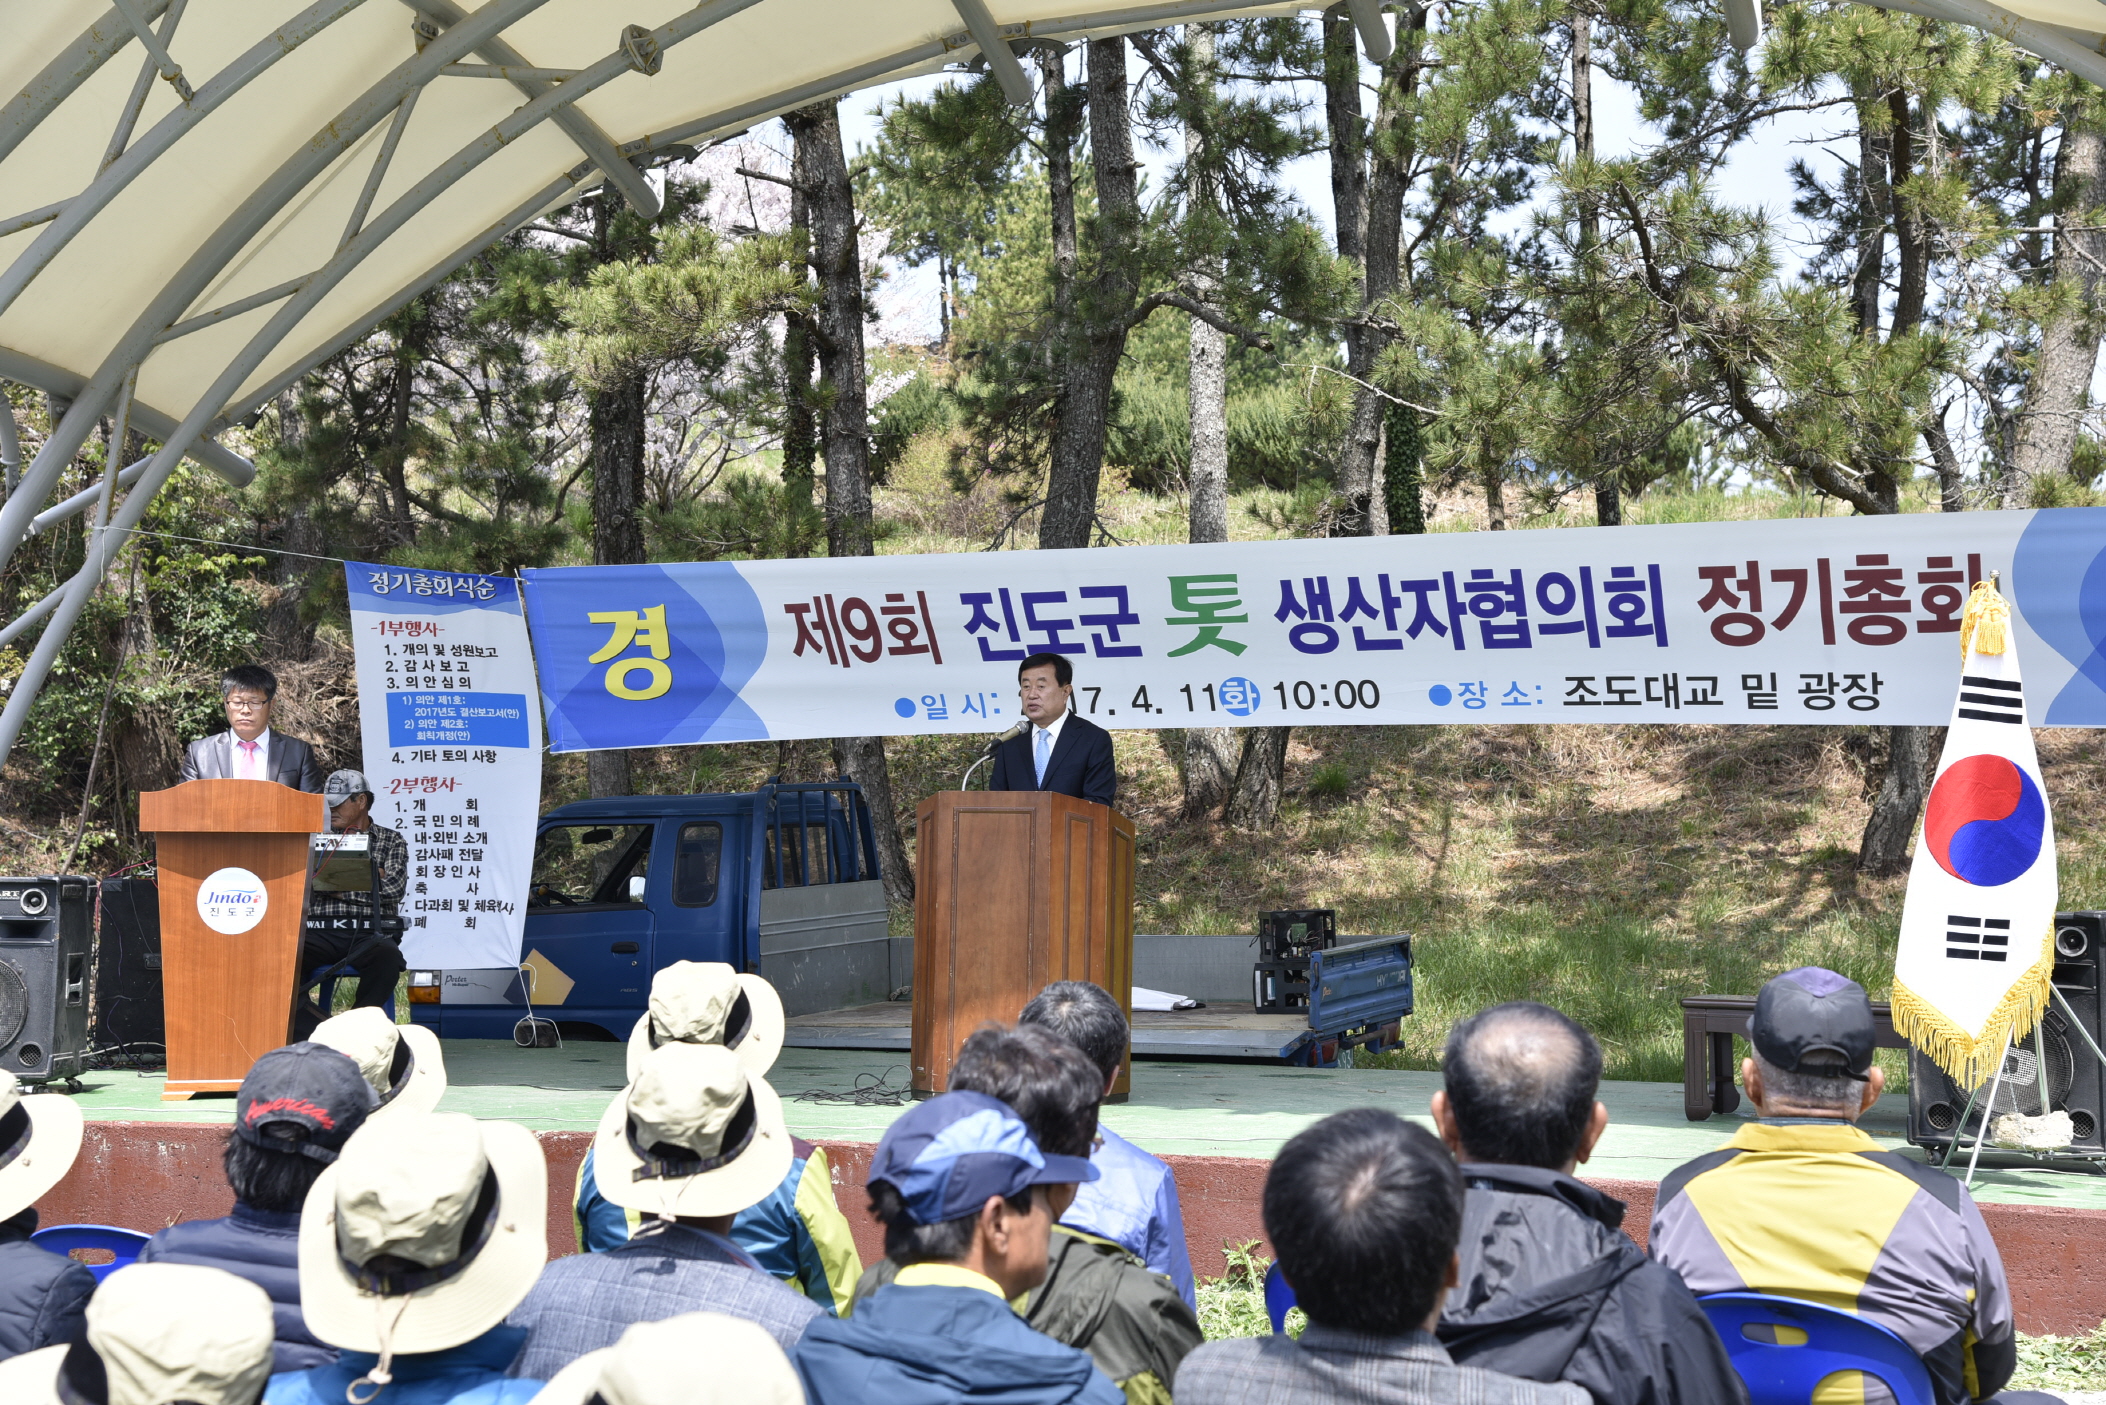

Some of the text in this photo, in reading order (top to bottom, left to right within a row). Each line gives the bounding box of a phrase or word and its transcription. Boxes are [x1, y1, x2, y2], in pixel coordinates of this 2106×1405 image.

[369, 571, 497, 600] 정기총회식순
[784, 553, 1982, 668] 제9회 진도군 톳 생산자협의회 정기총회
[384, 644, 498, 658] 1. 개의 및 성원보고
[587, 603, 673, 701] 경
[385, 661, 398, 673] 2.
[387, 677, 400, 689] 3.
[1273, 679, 1380, 711] 10:00
[1563, 673, 1724, 709] 조도대교
[1741, 673, 1778, 709] 밑
[1798, 672, 1884, 711] 광장
[415, 695, 435, 705] 의안
[414, 708, 520, 719] 2017년도 결산보고서(안)
[418, 719, 437, 728] 의안
[417, 730, 471, 741] 회칙개정(안)
[392, 750, 497, 764] 4. 기타 토의 사항
[395, 801, 407, 813] 1.
[395, 818, 408, 829] 2.
[463, 832, 488, 844] 소개
[415, 848, 483, 861] 감사패 전달
[415, 899, 453, 912] 다과회
[458, 900, 469, 912] 및
[306, 921, 325, 929] WAI
